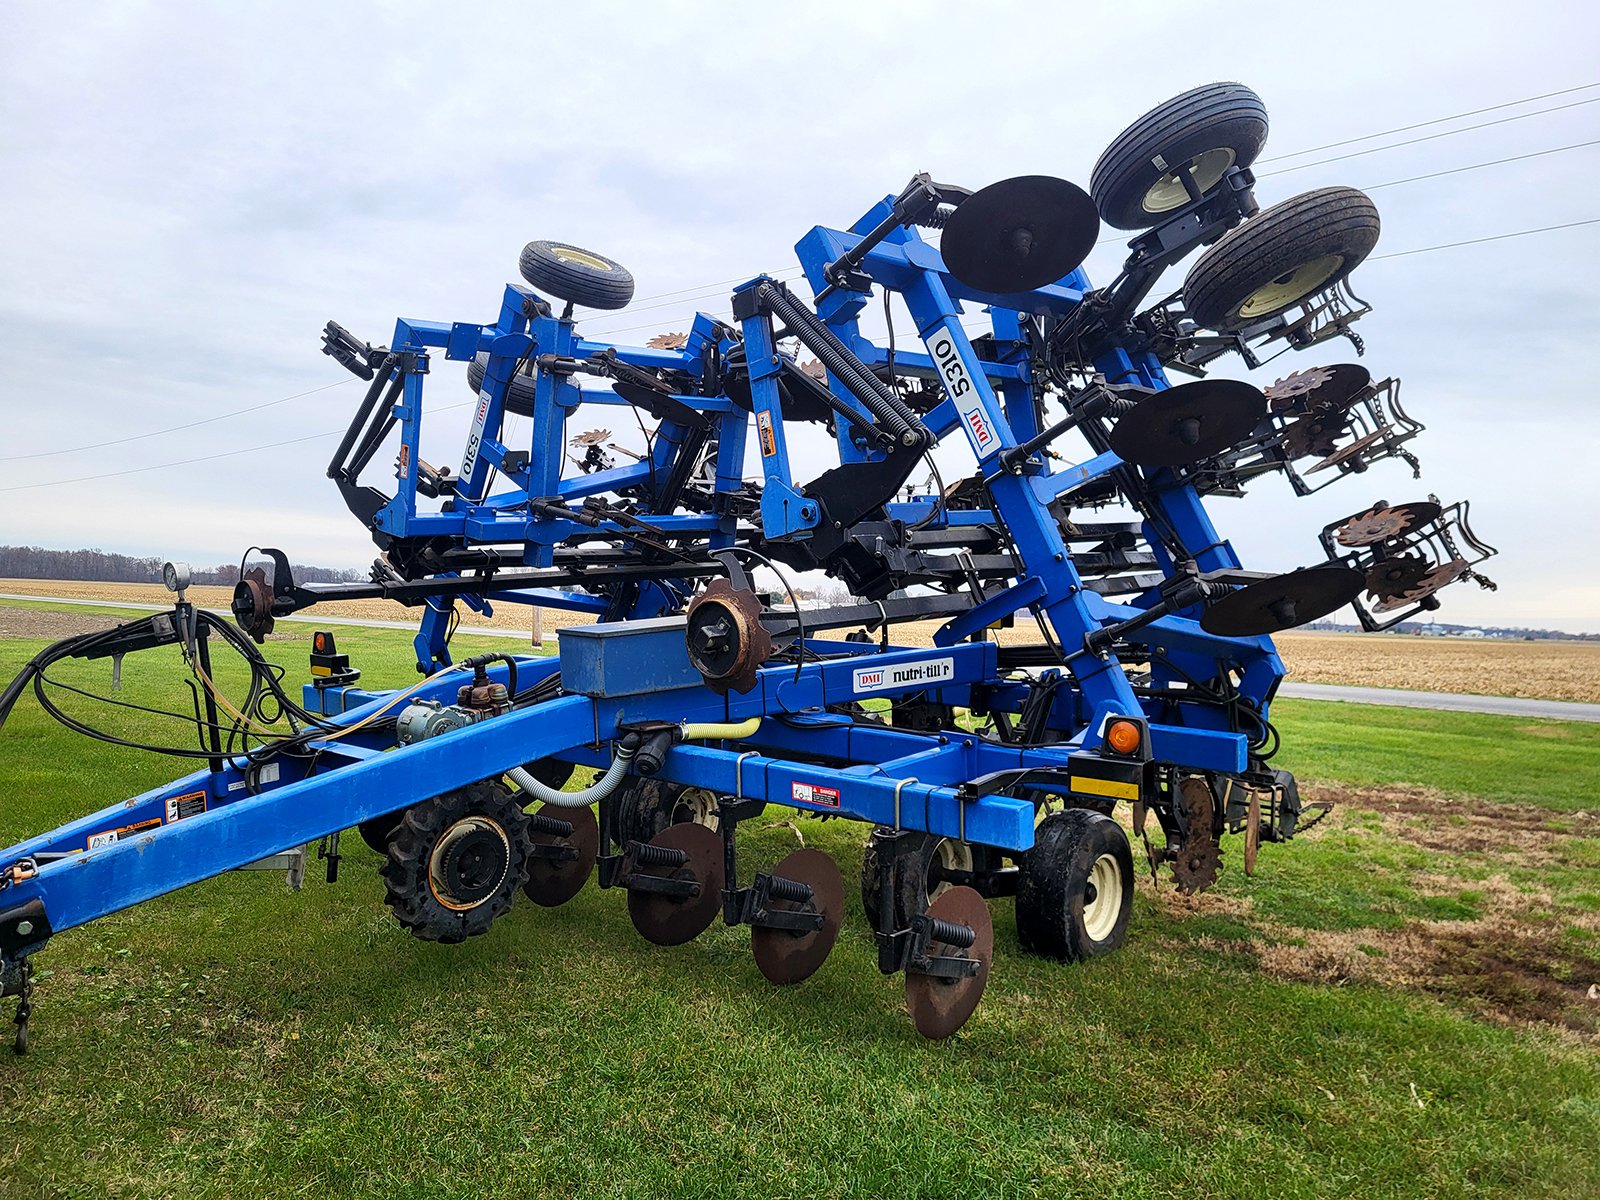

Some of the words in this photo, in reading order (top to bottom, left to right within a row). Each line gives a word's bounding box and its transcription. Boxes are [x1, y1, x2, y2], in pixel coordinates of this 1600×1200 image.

[935, 339, 970, 398] 5310
[478, 401, 488, 422] DMI
[970, 413, 988, 443] DMI
[463, 434, 479, 475] 5310
[862, 673, 880, 685] DMI
[893, 662, 949, 683] nutri-till'r
